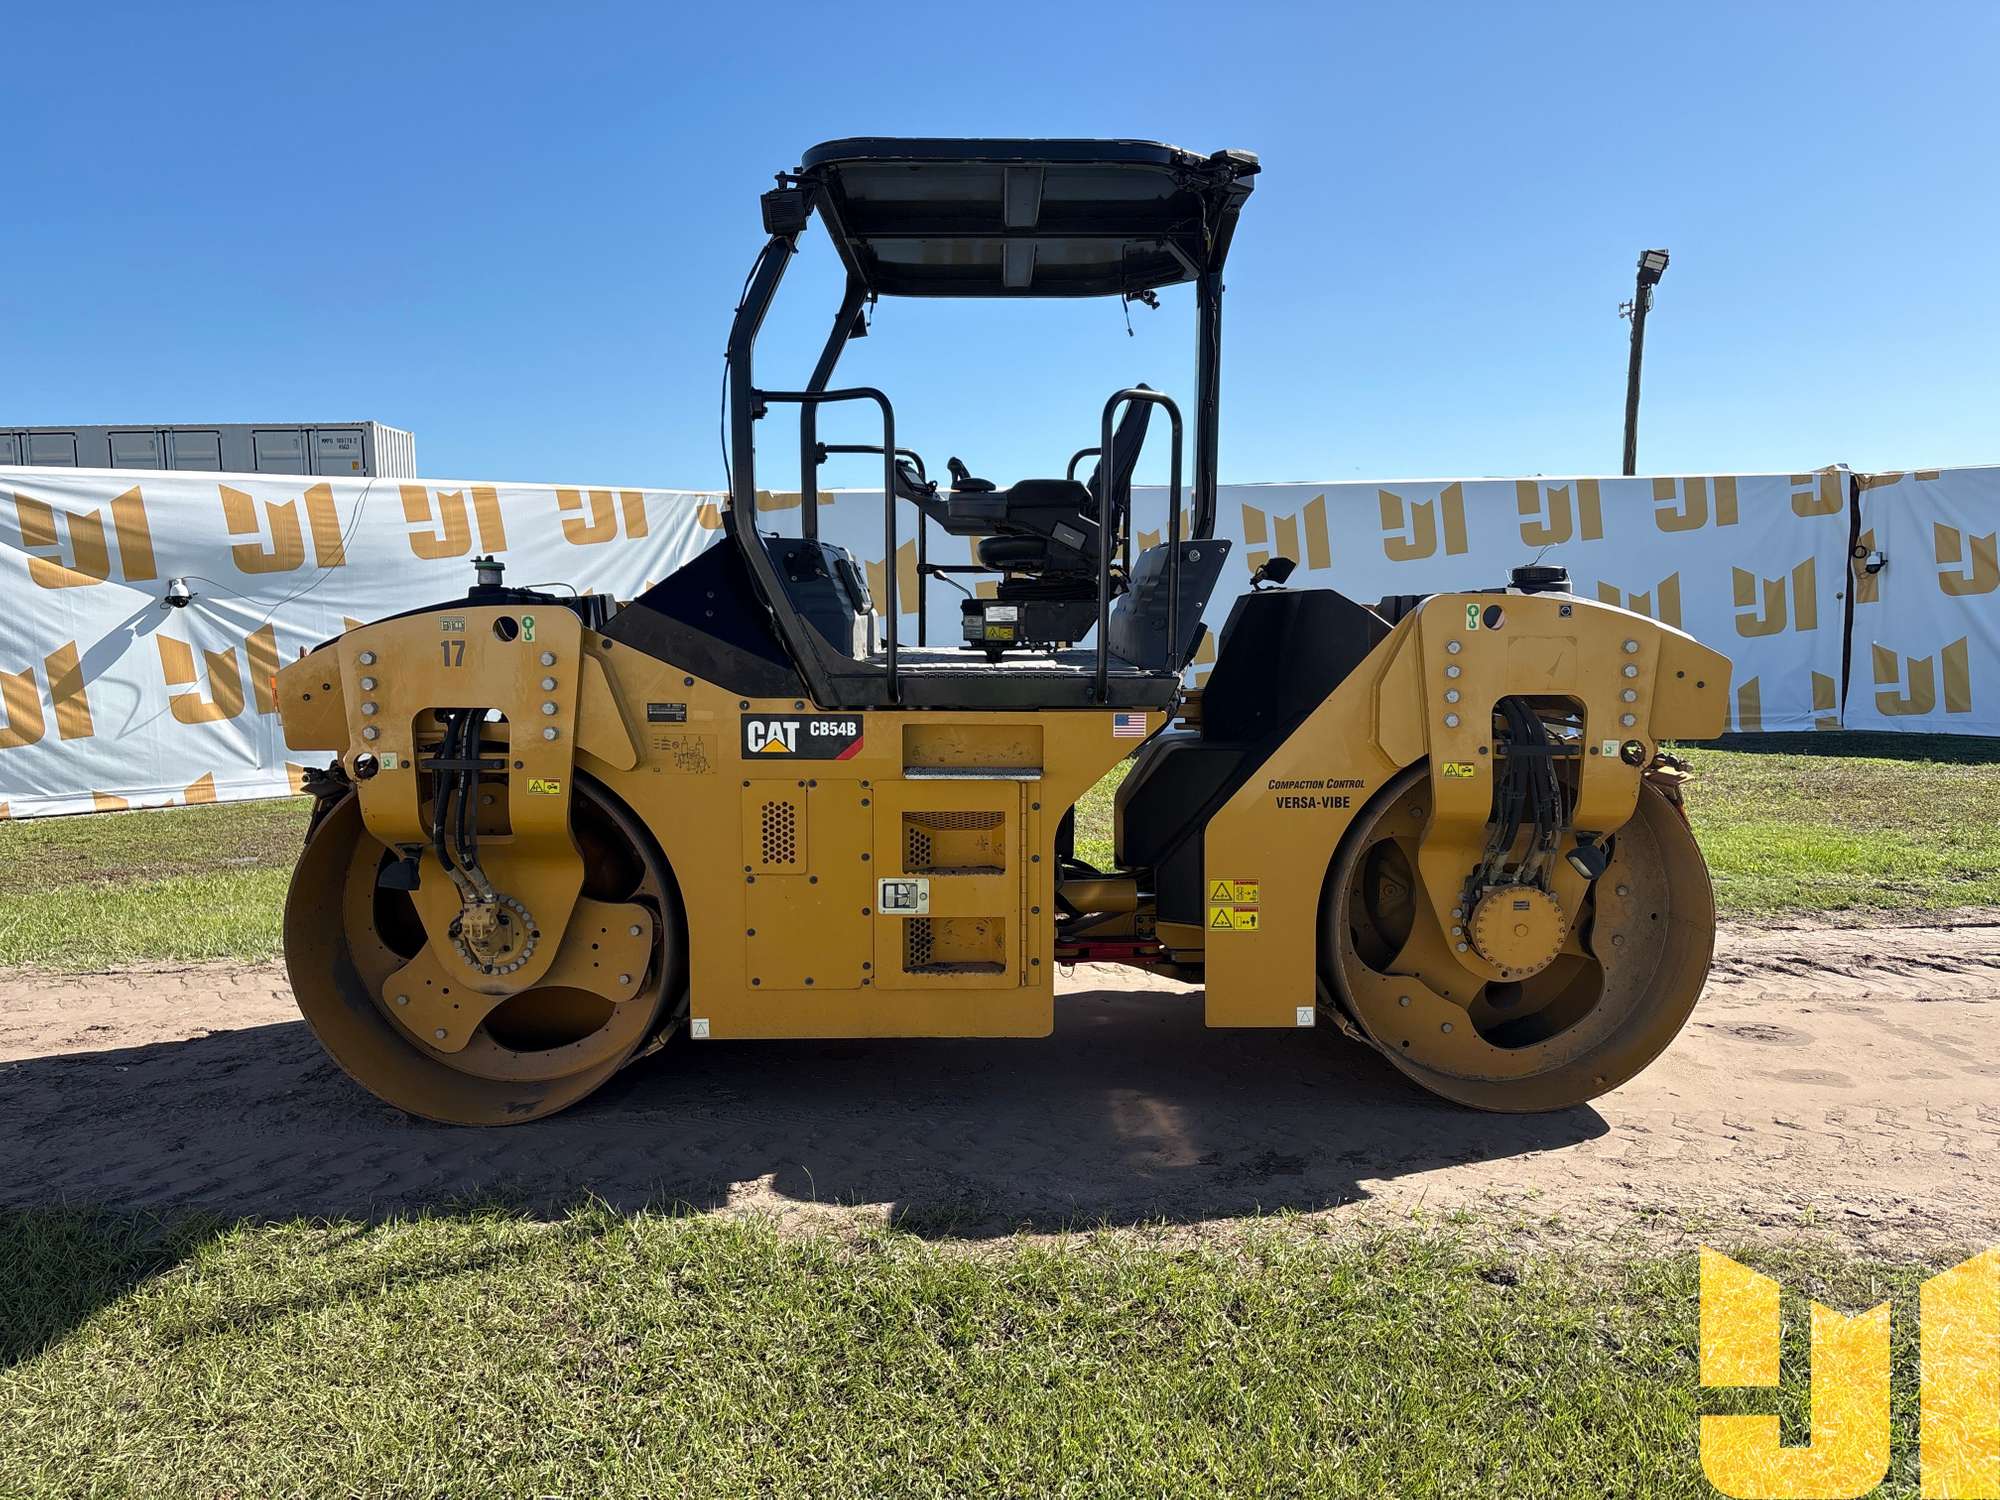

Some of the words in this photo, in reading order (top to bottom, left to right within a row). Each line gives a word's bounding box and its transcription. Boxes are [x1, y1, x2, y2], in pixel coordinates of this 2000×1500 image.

[440, 640, 466, 667] 17
[747, 720, 800, 753] CAT
[810, 721, 857, 736] CB54B
[1268, 779, 1324, 790] COMPACTION
[1326, 778, 1365, 789] CONTROL
[1276, 796, 1350, 809] VERSA-VIBE
